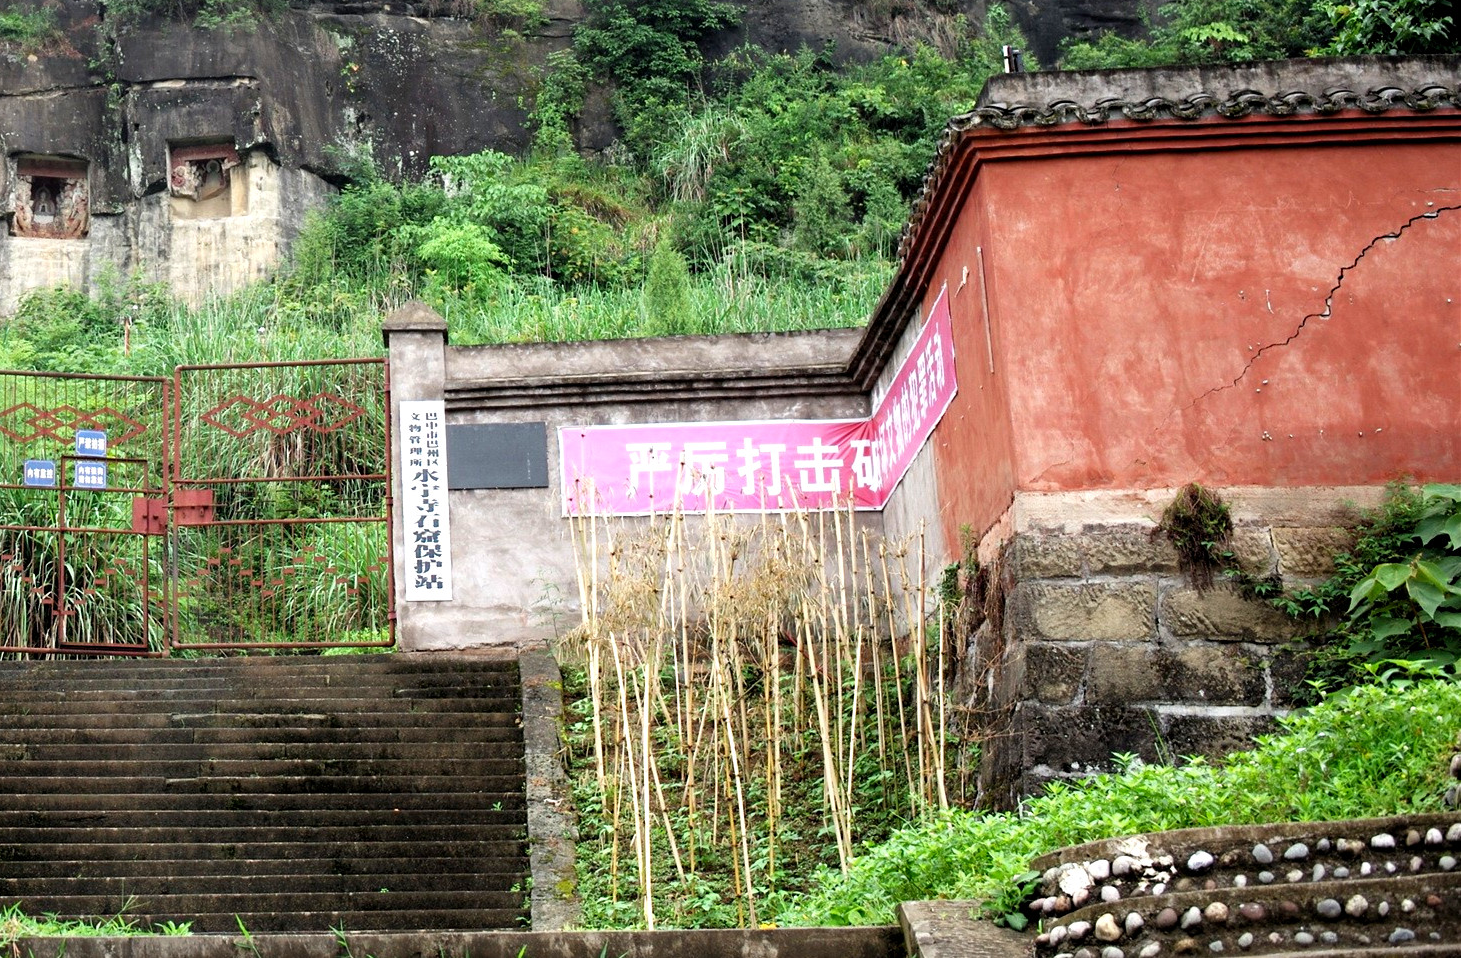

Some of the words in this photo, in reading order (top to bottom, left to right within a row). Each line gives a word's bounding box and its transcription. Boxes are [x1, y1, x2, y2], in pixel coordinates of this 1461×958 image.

[409, 413, 422, 467] 文物管理所
[425, 413, 439, 466] 巴中市巴州区
